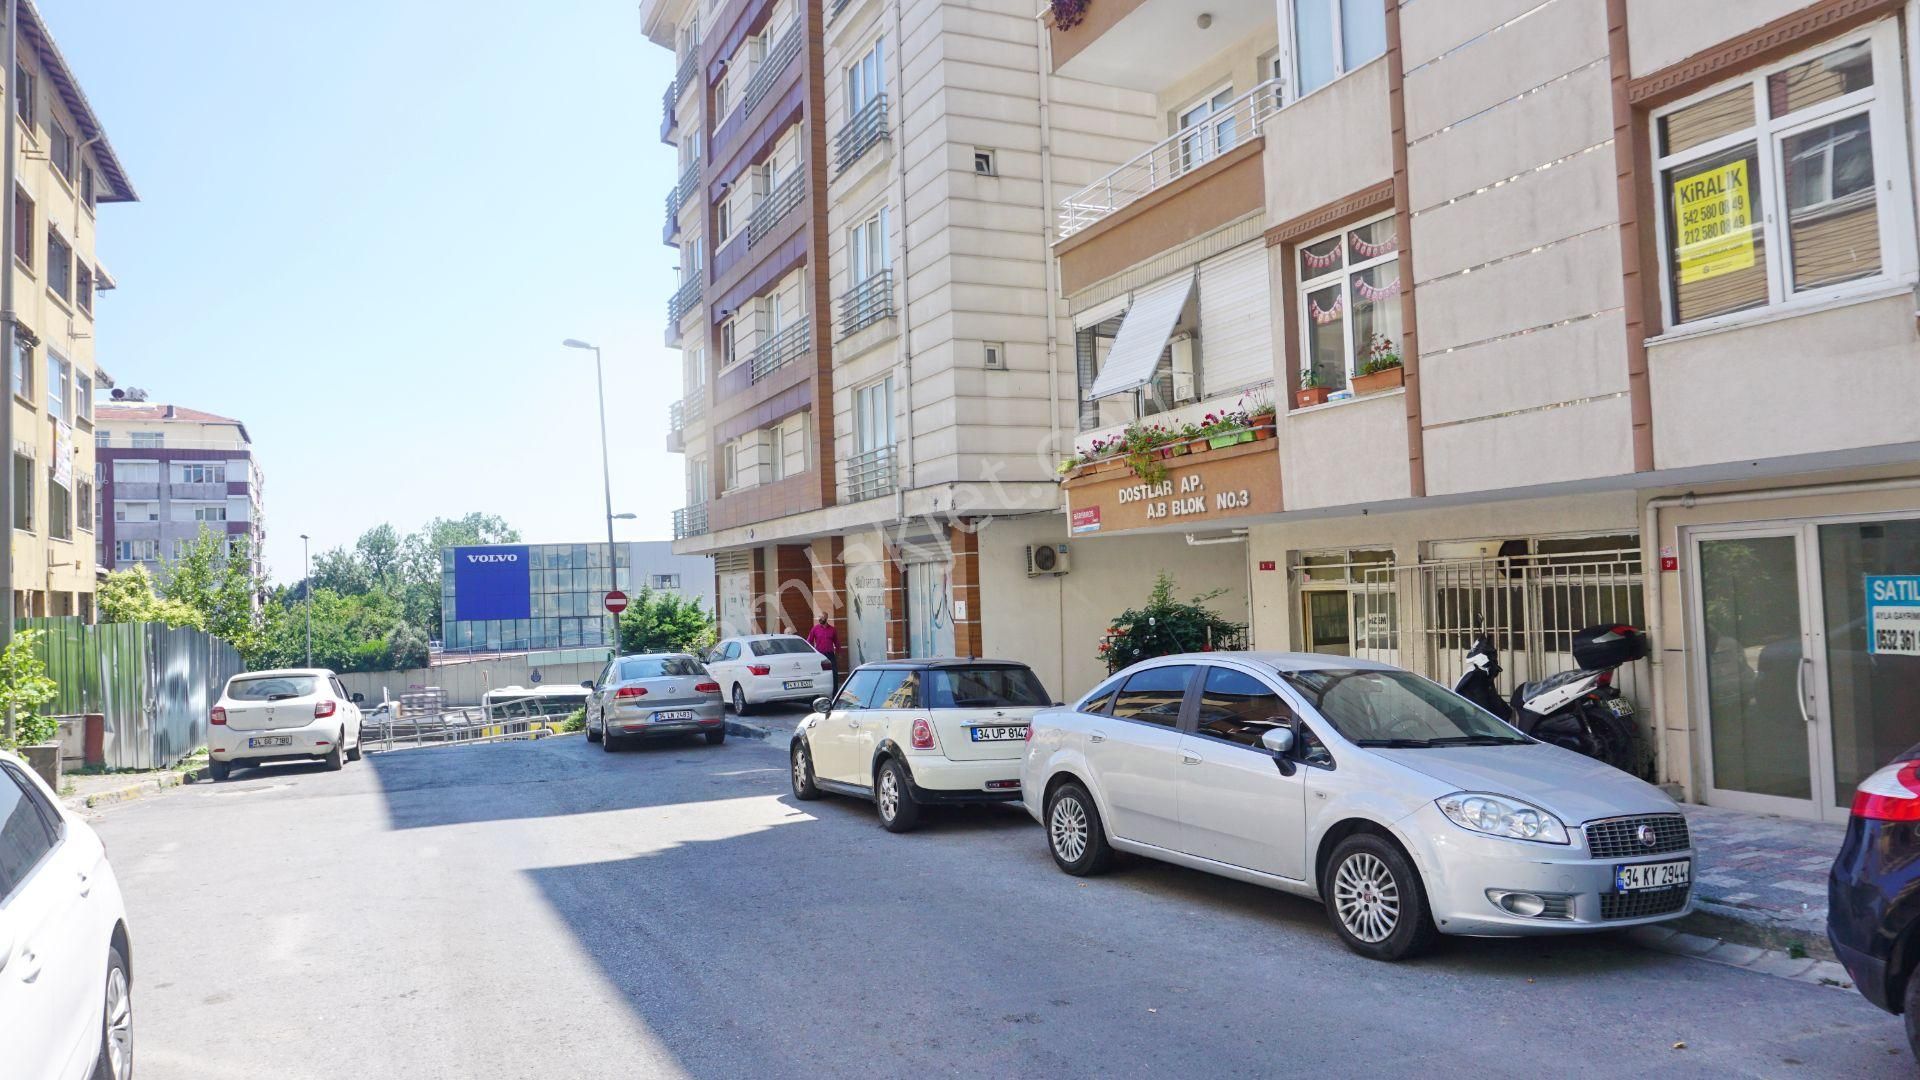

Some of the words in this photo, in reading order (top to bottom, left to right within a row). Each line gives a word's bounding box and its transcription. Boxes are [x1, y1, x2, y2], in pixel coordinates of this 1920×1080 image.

[1683, 208, 1699, 226] 542
[1700, 204, 1717, 221] 580
[1684, 227, 1700, 245] 212
[1702, 222, 1719, 240] 580
[1119, 480, 1173, 504] DOSTLAR
[1180, 475, 1204, 493] AP.
[1146, 502, 1167, 519] A.B
[1171, 496, 1206, 516] BLOK
[1216, 490, 1249, 510] NO.3
[467, 554, 518, 563] VOLVO
[1876, 612, 1892, 620] AYLA
[1876, 629, 1898, 650] 0532
[1900, 629, 1915, 651] 361
[978, 729, 989, 739] 34
[992, 729, 1005, 739] UP
[1008, 727, 1028, 738] 8142
[1625, 868, 1638, 887] 34
[1643, 867, 1657, 885] KY
[1662, 863, 1685, 884] 2944
